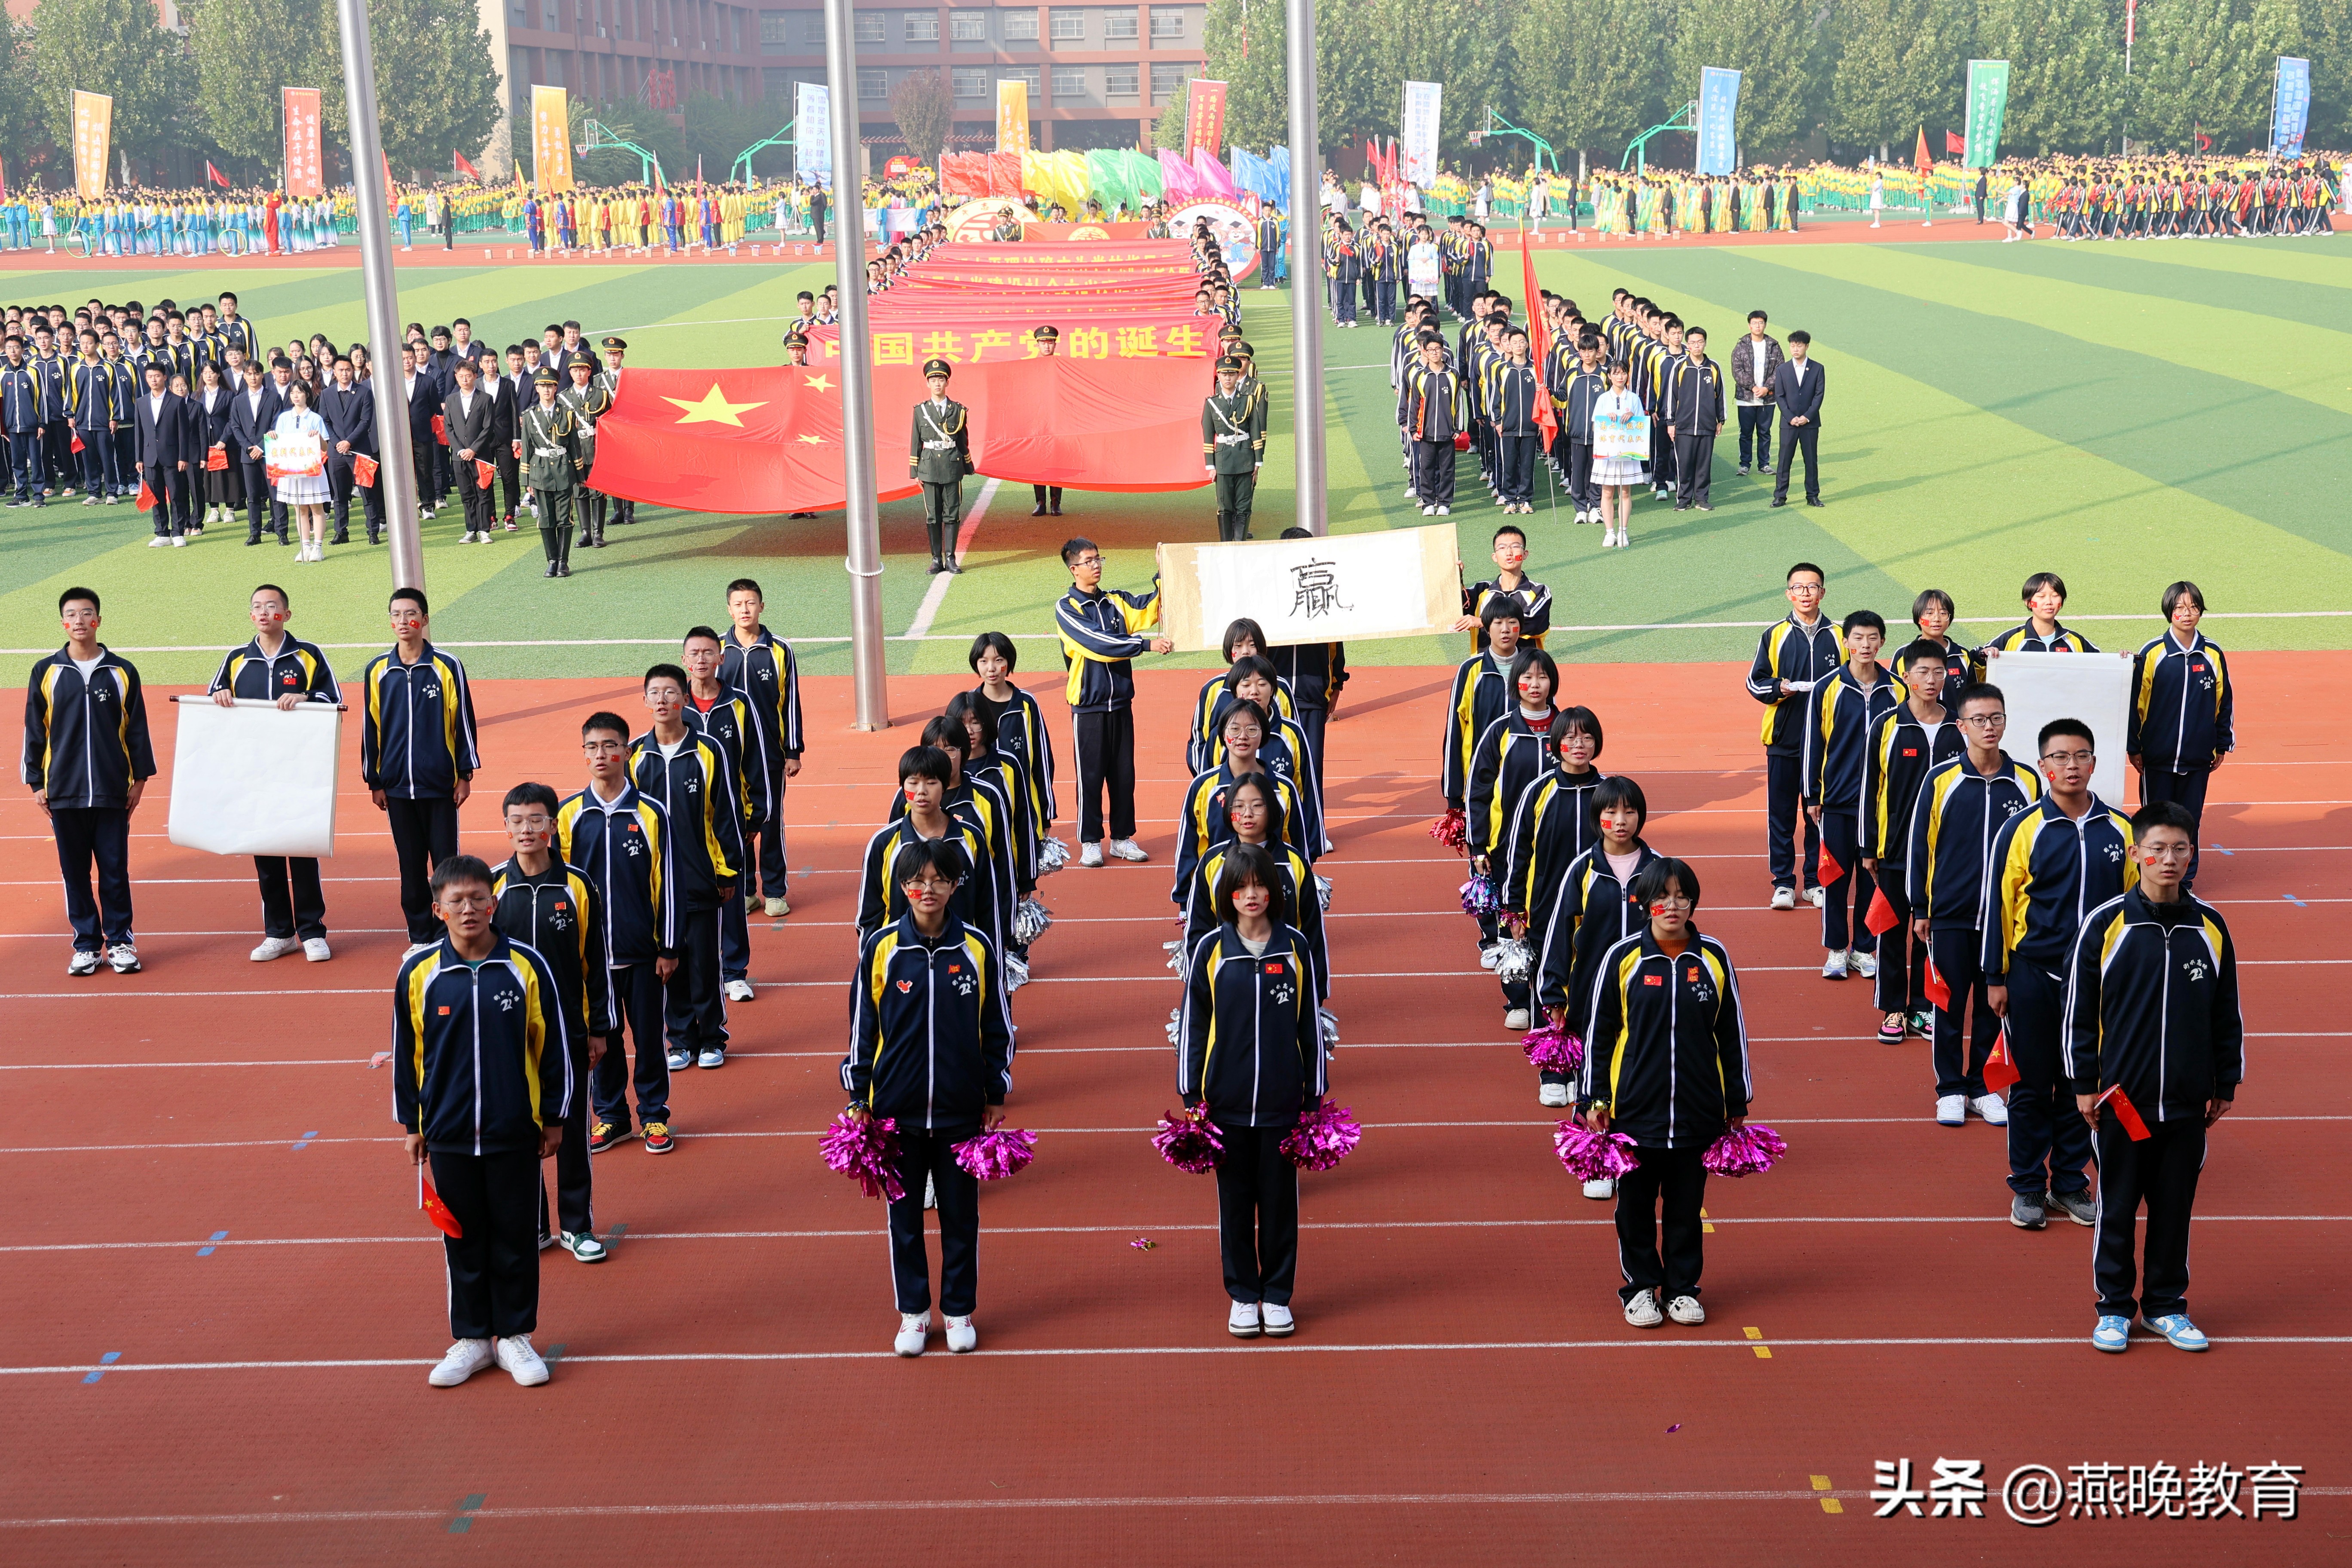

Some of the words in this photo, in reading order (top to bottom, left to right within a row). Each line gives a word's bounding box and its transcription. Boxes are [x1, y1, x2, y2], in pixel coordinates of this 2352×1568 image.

[292, 104, 303, 179] 生命在于健康
[305, 113, 317, 188] 健康在于锻炼
[825, 325, 1207, 366] 国共产的诞生
[2183, 959, 2208, 970] 衡水志臻
